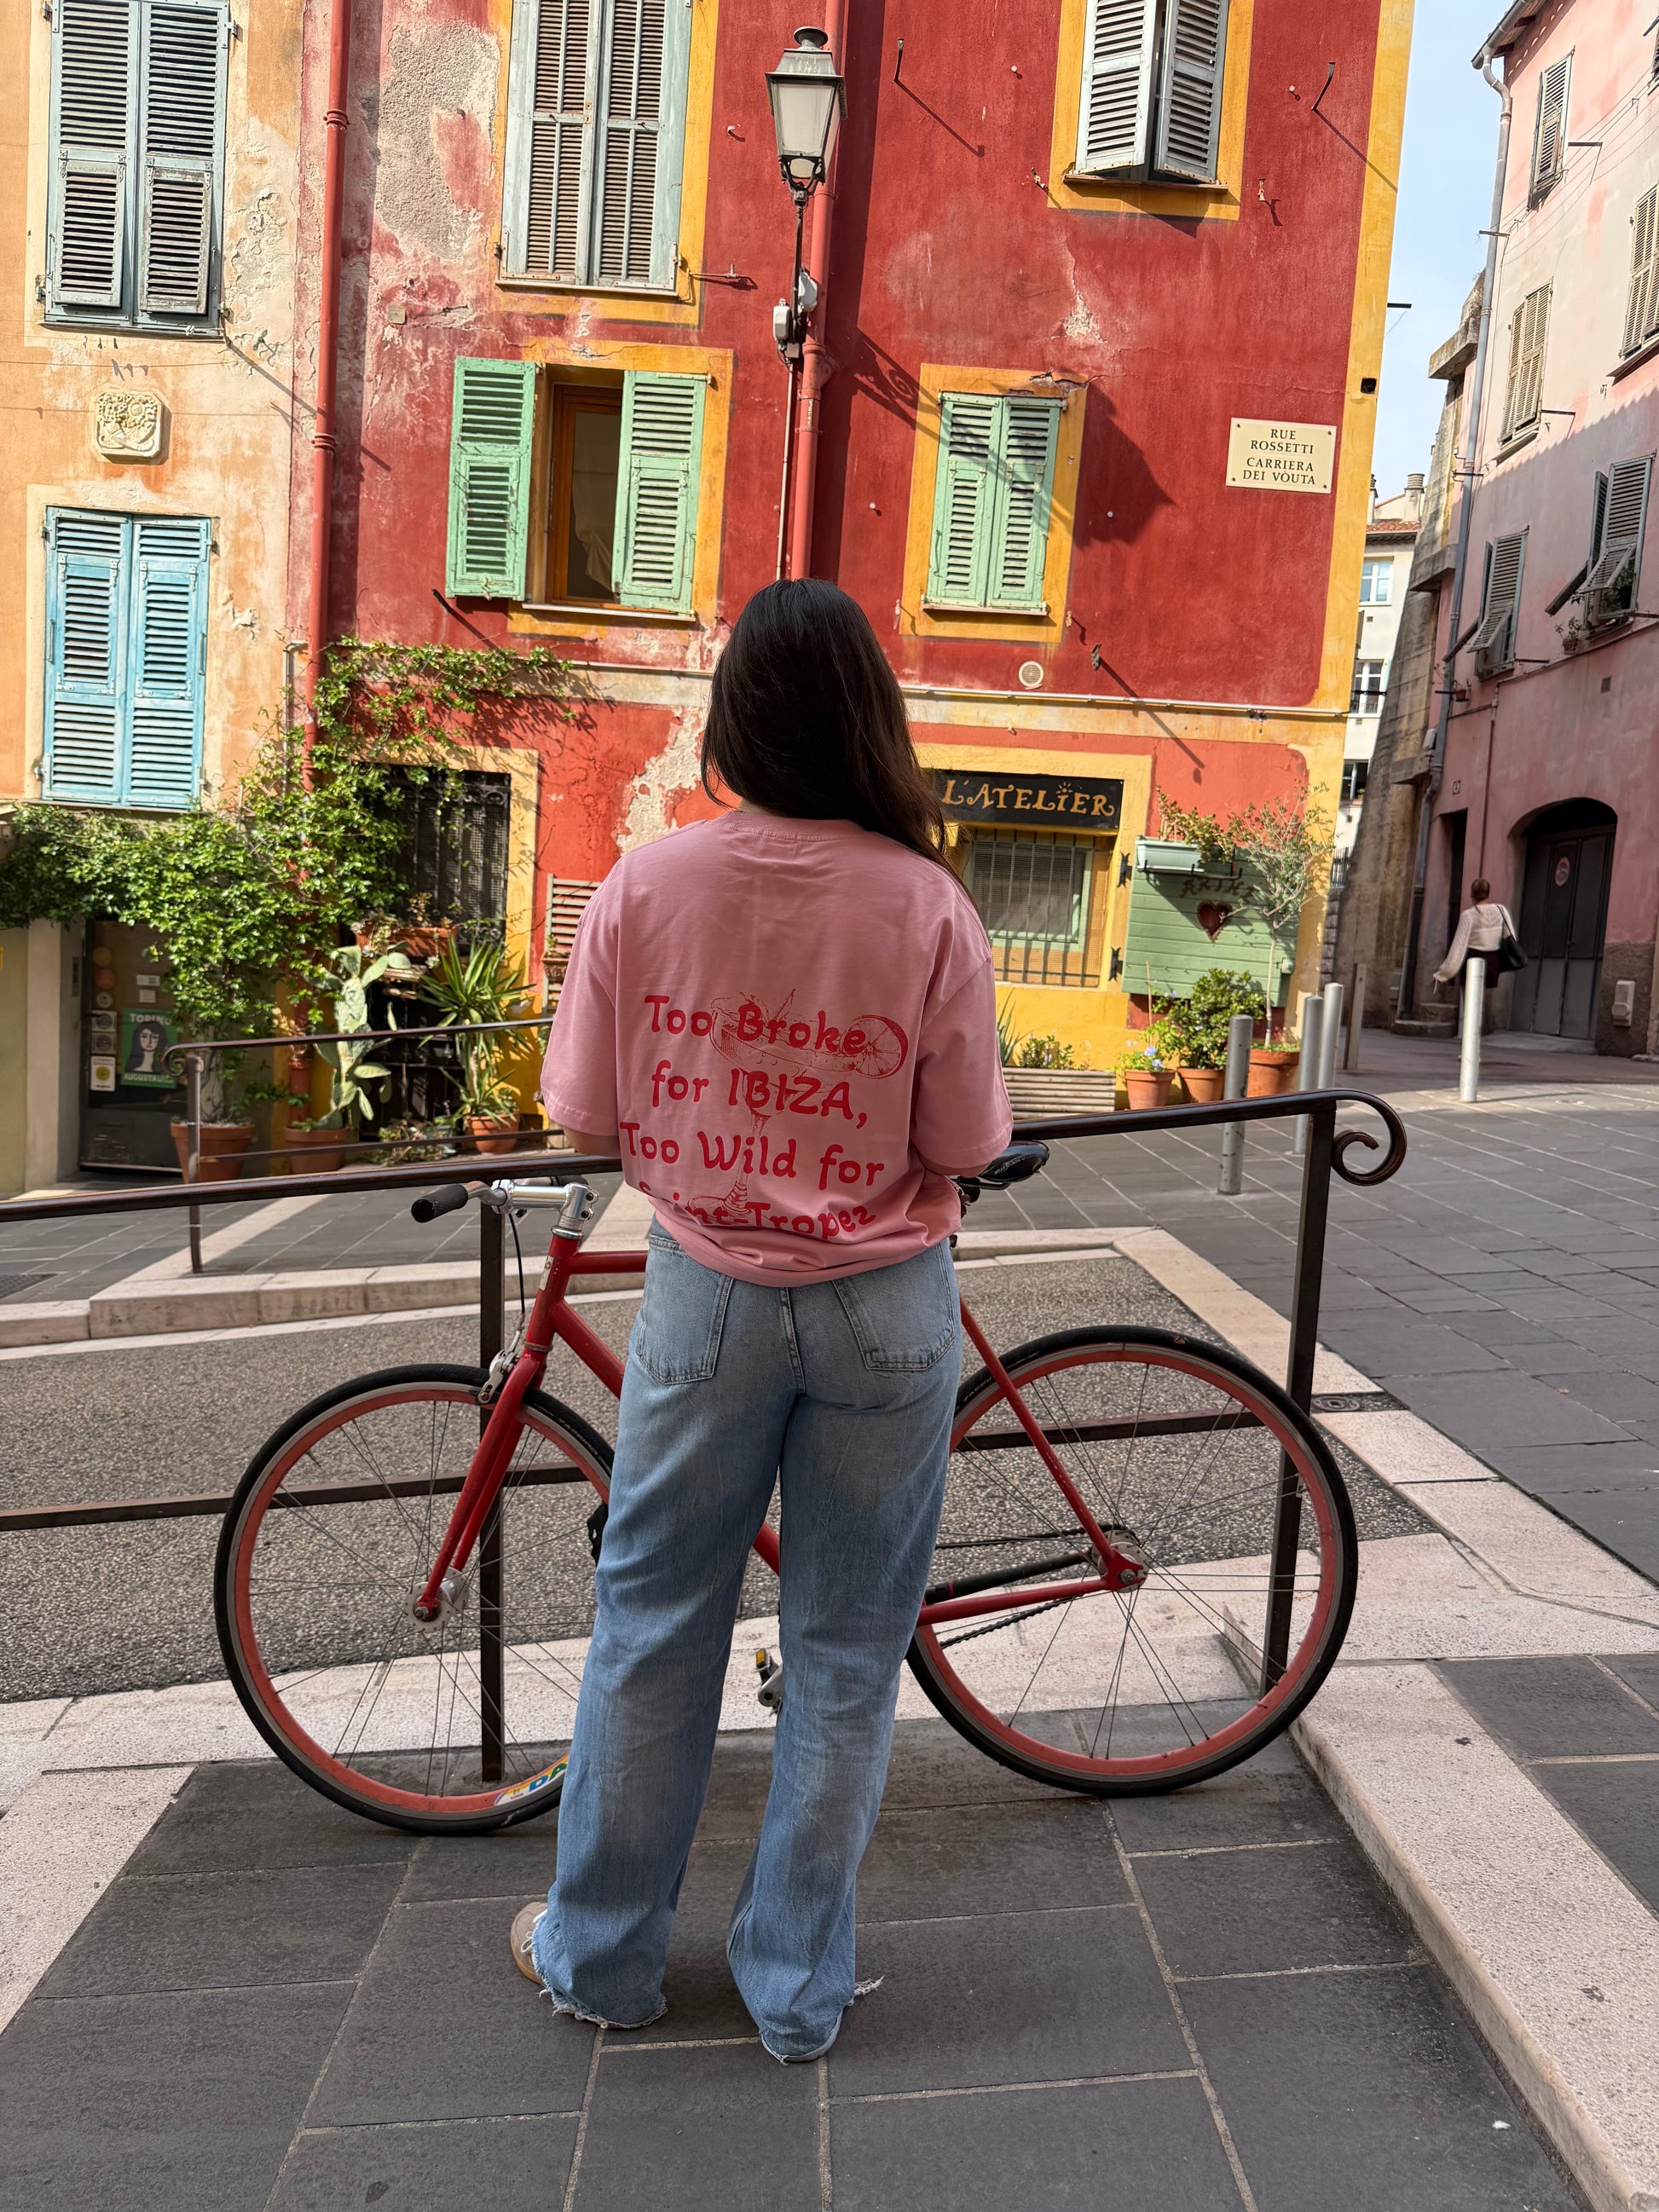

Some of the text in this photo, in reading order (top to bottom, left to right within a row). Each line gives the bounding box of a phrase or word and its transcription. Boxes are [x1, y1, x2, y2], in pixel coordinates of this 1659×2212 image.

[1251, 440, 1314, 453] ROSSETTI
[1270, 429, 1296, 440] RUE
[1242, 470, 1315, 484] DEI VÒUTA
[1246, 457, 1314, 471] CARRIERA
[941, 779, 1115, 817] L'ATELIER
[645, 995, 866, 1054] Too Broke
[651, 1060, 867, 1129] for IBIZA,
[620, 1122, 884, 1190] Too Wild for
